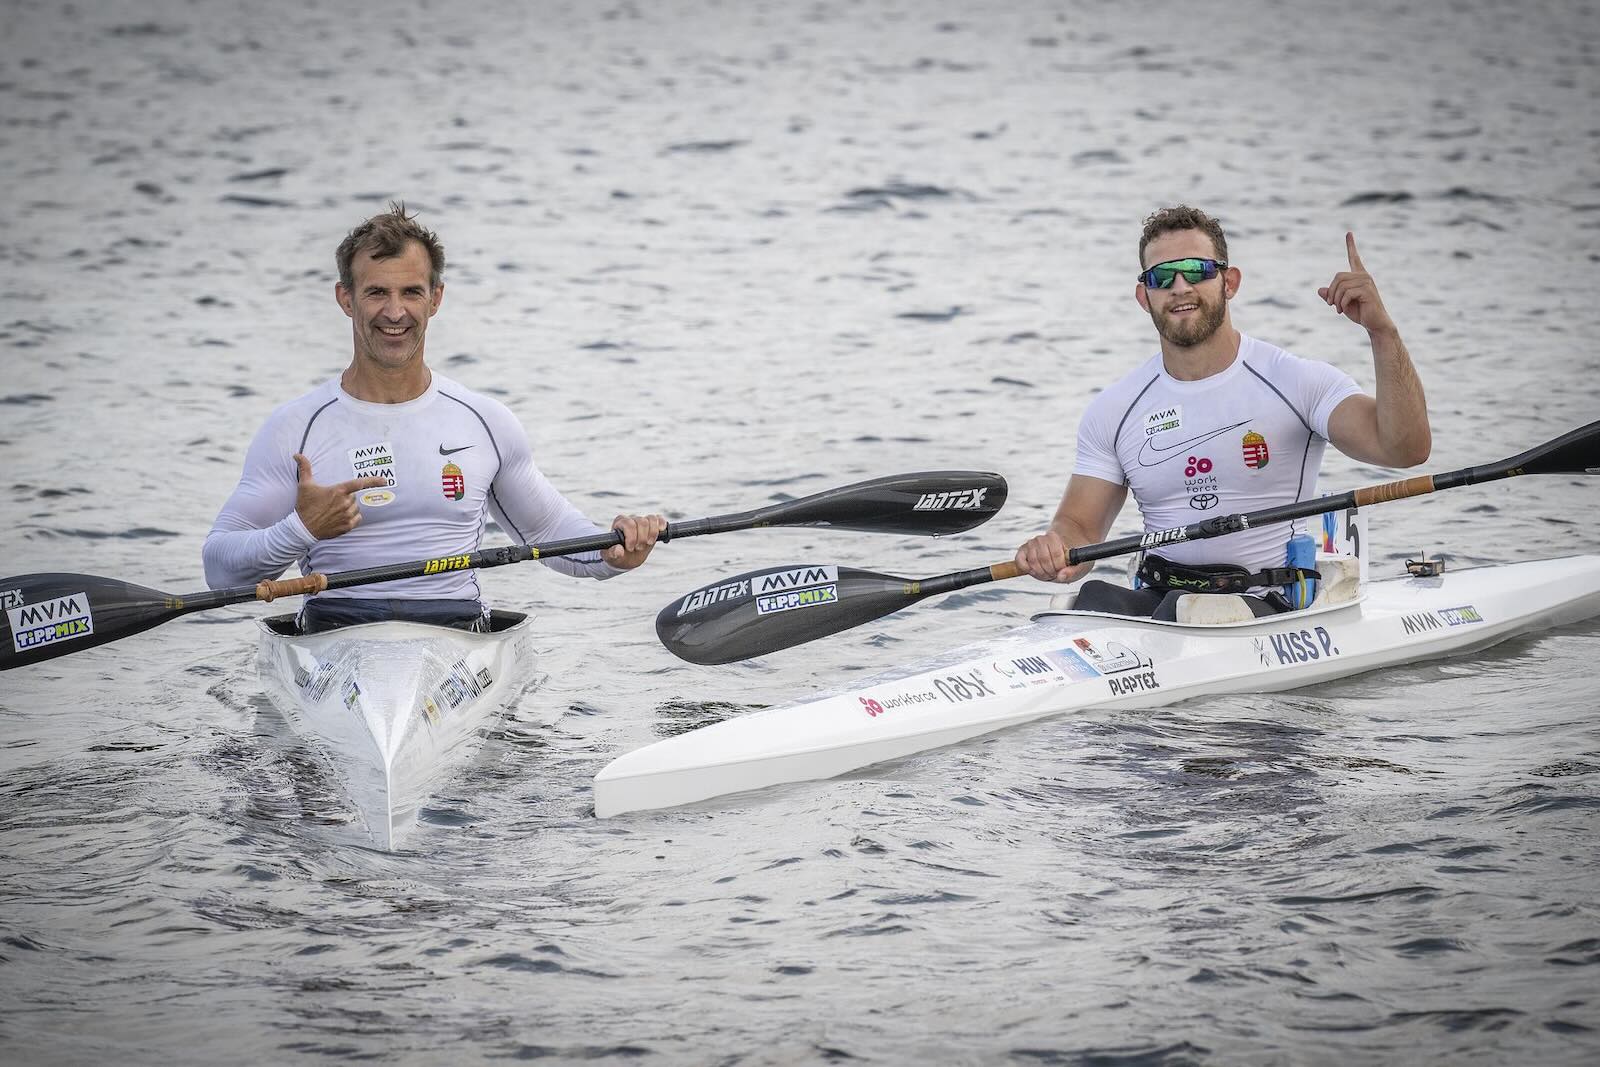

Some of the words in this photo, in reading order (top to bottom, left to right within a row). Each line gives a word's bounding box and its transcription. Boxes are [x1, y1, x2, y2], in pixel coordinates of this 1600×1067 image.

[1149, 409, 1176, 422] MVM
[355, 446, 387, 458] MVM
[1184, 475, 1217, 486] work
[1186, 484, 1218, 494] force
[761, 567, 829, 592] MVM
[20, 598, 81, 627] MVM
[1400, 611, 1443, 635] MVM
[1269, 629, 1320, 665] KISS
[1314, 626, 1339, 657] P.
[1010, 655, 1054, 676] HUN
[881, 691, 937, 709] workforce
